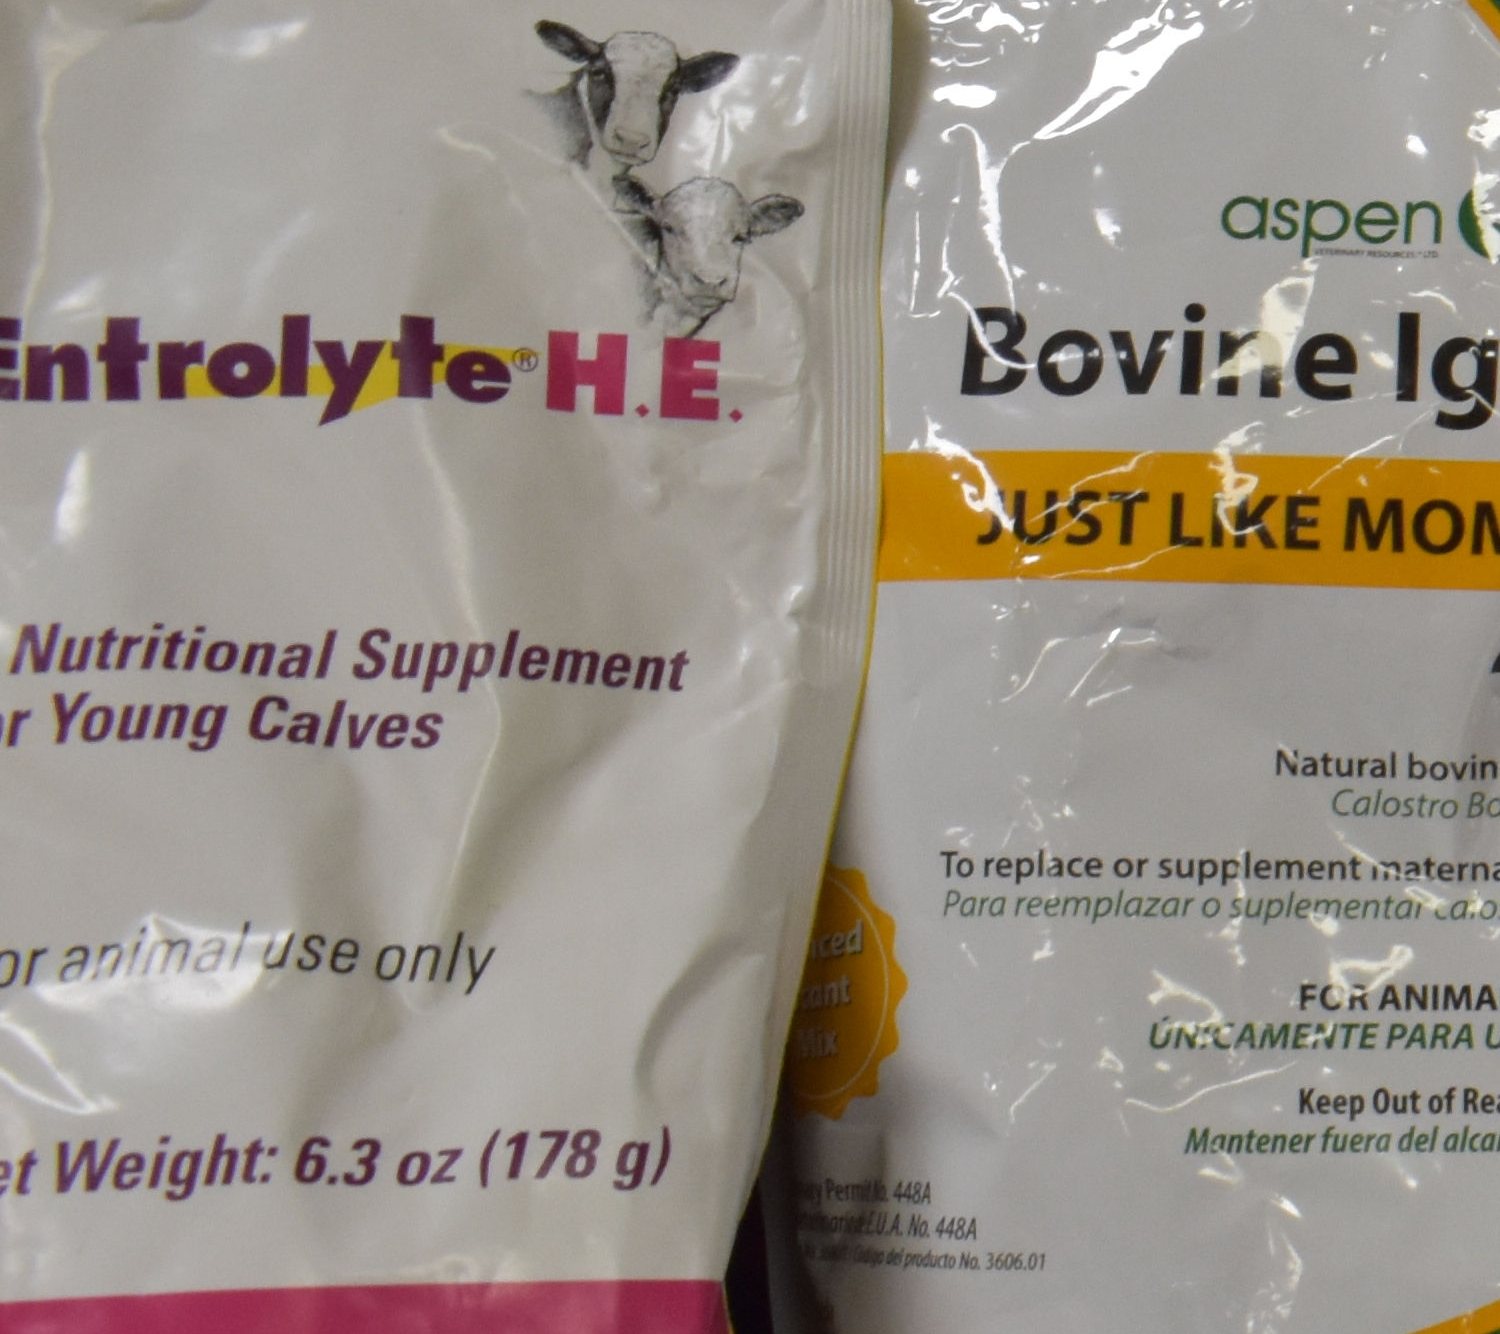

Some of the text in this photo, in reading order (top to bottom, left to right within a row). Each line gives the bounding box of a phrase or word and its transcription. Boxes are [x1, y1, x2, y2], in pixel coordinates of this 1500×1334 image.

[1221, 195, 1442, 258] aspen
[960, 304, 1357, 401] Bovine
[546, 330, 743, 422] H.E.
[976, 490, 1148, 547] JUST
[1169, 492, 1320, 552] LIKE
[10, 622, 689, 694] Nutritional Supplement
[52, 691, 228, 752] Young
[248, 695, 443, 750] Calves
[1275, 750, 1397, 779] Natural
[1330, 789, 1459, 820] Calostro
[940, 852, 974, 879] To
[983, 851, 1103, 886] replace
[1112, 857, 1150, 879] or
[1158, 852, 1361, 886] supplement
[944, 891, 1005, 919] Para
[1014, 891, 1193, 923] reemplazar
[1202, 898, 1221, 919] o
[1229, 891, 1424, 924] suplementar
[58, 920, 496, 995] animal use only
[1299, 984, 1369, 1012] FOR
[1150, 1015, 1377, 1051] ÚNICAMENTE
[1387, 1022, 1475, 1051] PARA
[1299, 1088, 1364, 1123] Keep
[1373, 1088, 1420, 1116] Out
[1427, 1088, 1457, 1116] of
[1185, 1127, 1314, 1154] Mantener
[1321, 1127, 1390, 1155] fuera
[1398, 1126, 1438, 1154] del
[55, 1124, 672, 1201] Weight: 6.3 oz (178 g)
[936, 1217, 976, 1241] 448A
